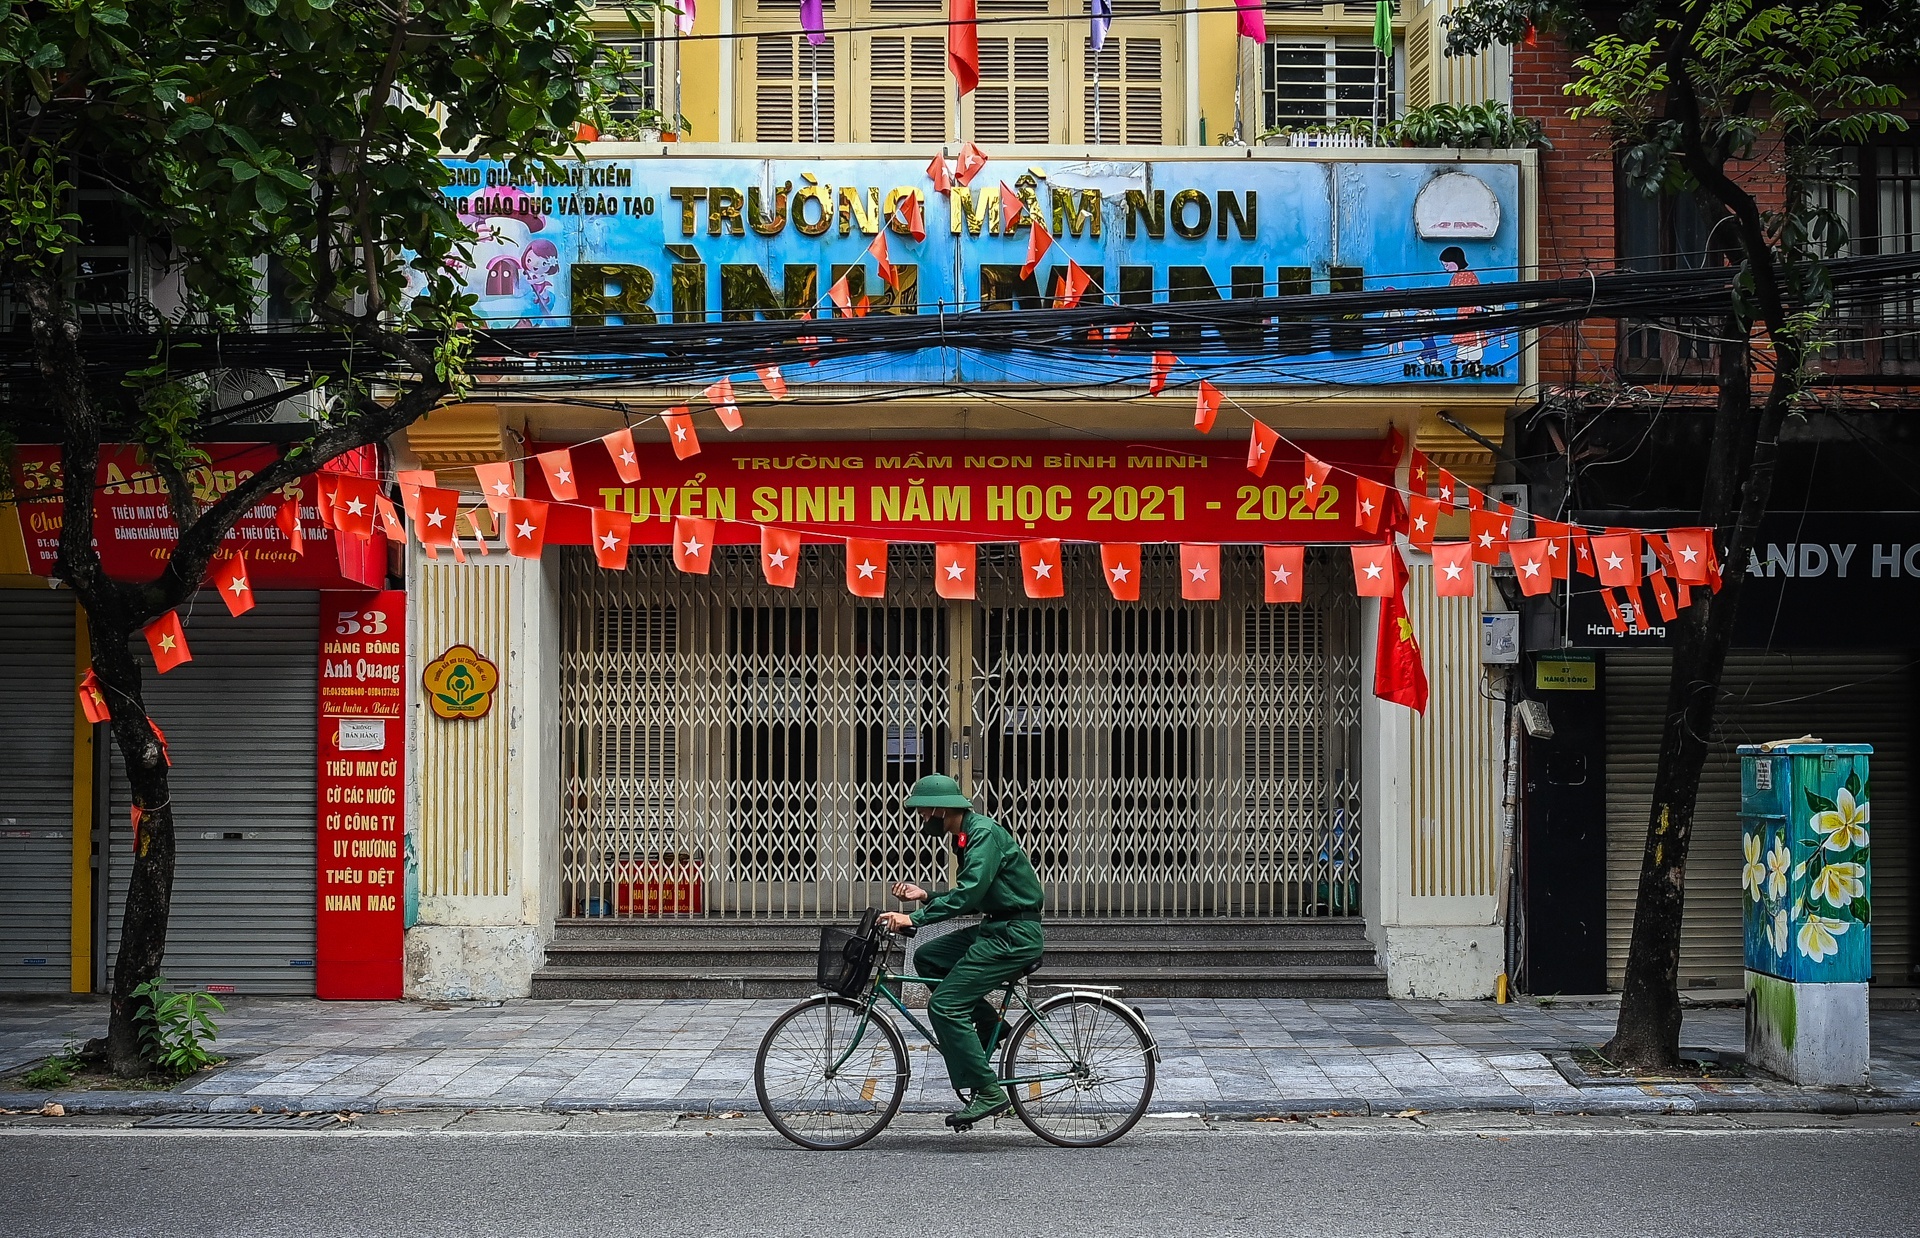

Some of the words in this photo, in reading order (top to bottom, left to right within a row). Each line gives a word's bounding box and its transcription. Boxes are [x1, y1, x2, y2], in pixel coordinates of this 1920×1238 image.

[447, 168, 480, 187] BND
[589, 162, 631, 187] KIẾM
[474, 193, 514, 215] GIÁO
[519, 197, 553, 219] DỤC
[558, 193, 580, 216] VÀ
[584, 192, 618, 216] ĐÀO
[623, 196, 655, 219] TẠO
[669, 172, 925, 237] TRƯỜNG
[1124, 188, 1258, 240] NON
[732, 453, 864, 469] TRƯỜNG
[875, 451, 953, 469] MẦM
[964, 456, 1032, 469] NON
[1044, 452, 1116, 469] BÌNH
[1128, 455, 1208, 469] MINH
[187, 464, 304, 502] Quag
[598, 472, 736, 524] TUYỂN
[751, 485, 855, 522] SINH
[870, 477, 971, 522] NĂM
[986, 485, 1072, 529] HỌC
[1087, 485, 1185, 521] 2021
[1206, 501, 1221, 510] -
[1236, 485, 1340, 521] 2022
[137, 506, 155, 520] MAY
[241, 526, 263, 540] THÊU
[264, 526, 280, 543] DỆT
[309, 526, 328, 541] MÁC
[1718, 543, 1858, 578] ANDY
[335, 610, 388, 635] 53
[324, 639, 360, 654] HÀNG
[365, 639, 400, 655] BÔNG
[323, 658, 352, 678] Anh
[356, 658, 400, 684] Quang
[322, 700, 341, 713] Bán
[371, 702, 390, 714] Bán
[345, 731, 359, 739] BÁN
[360, 731, 379, 739] HÀNG
[326, 758, 353, 777] THÊU
[356, 761, 379, 777] MAY
[380, 757, 398, 777] CỜ
[326, 785, 341, 804] CỜ
[344, 785, 364, 804] CÁC
[366, 785, 396, 805] NƯỚC
[326, 812, 341, 831] CỜ
[344, 812, 379, 831] CÔNG
[382, 815, 396, 831] TY
[333, 840, 349, 858] UY
[351, 838, 397, 858] CHƯƠNG
[368, 867, 395, 887] DỆT
[325, 895, 361, 912] NHAN
[367, 895, 396, 912] MAC
